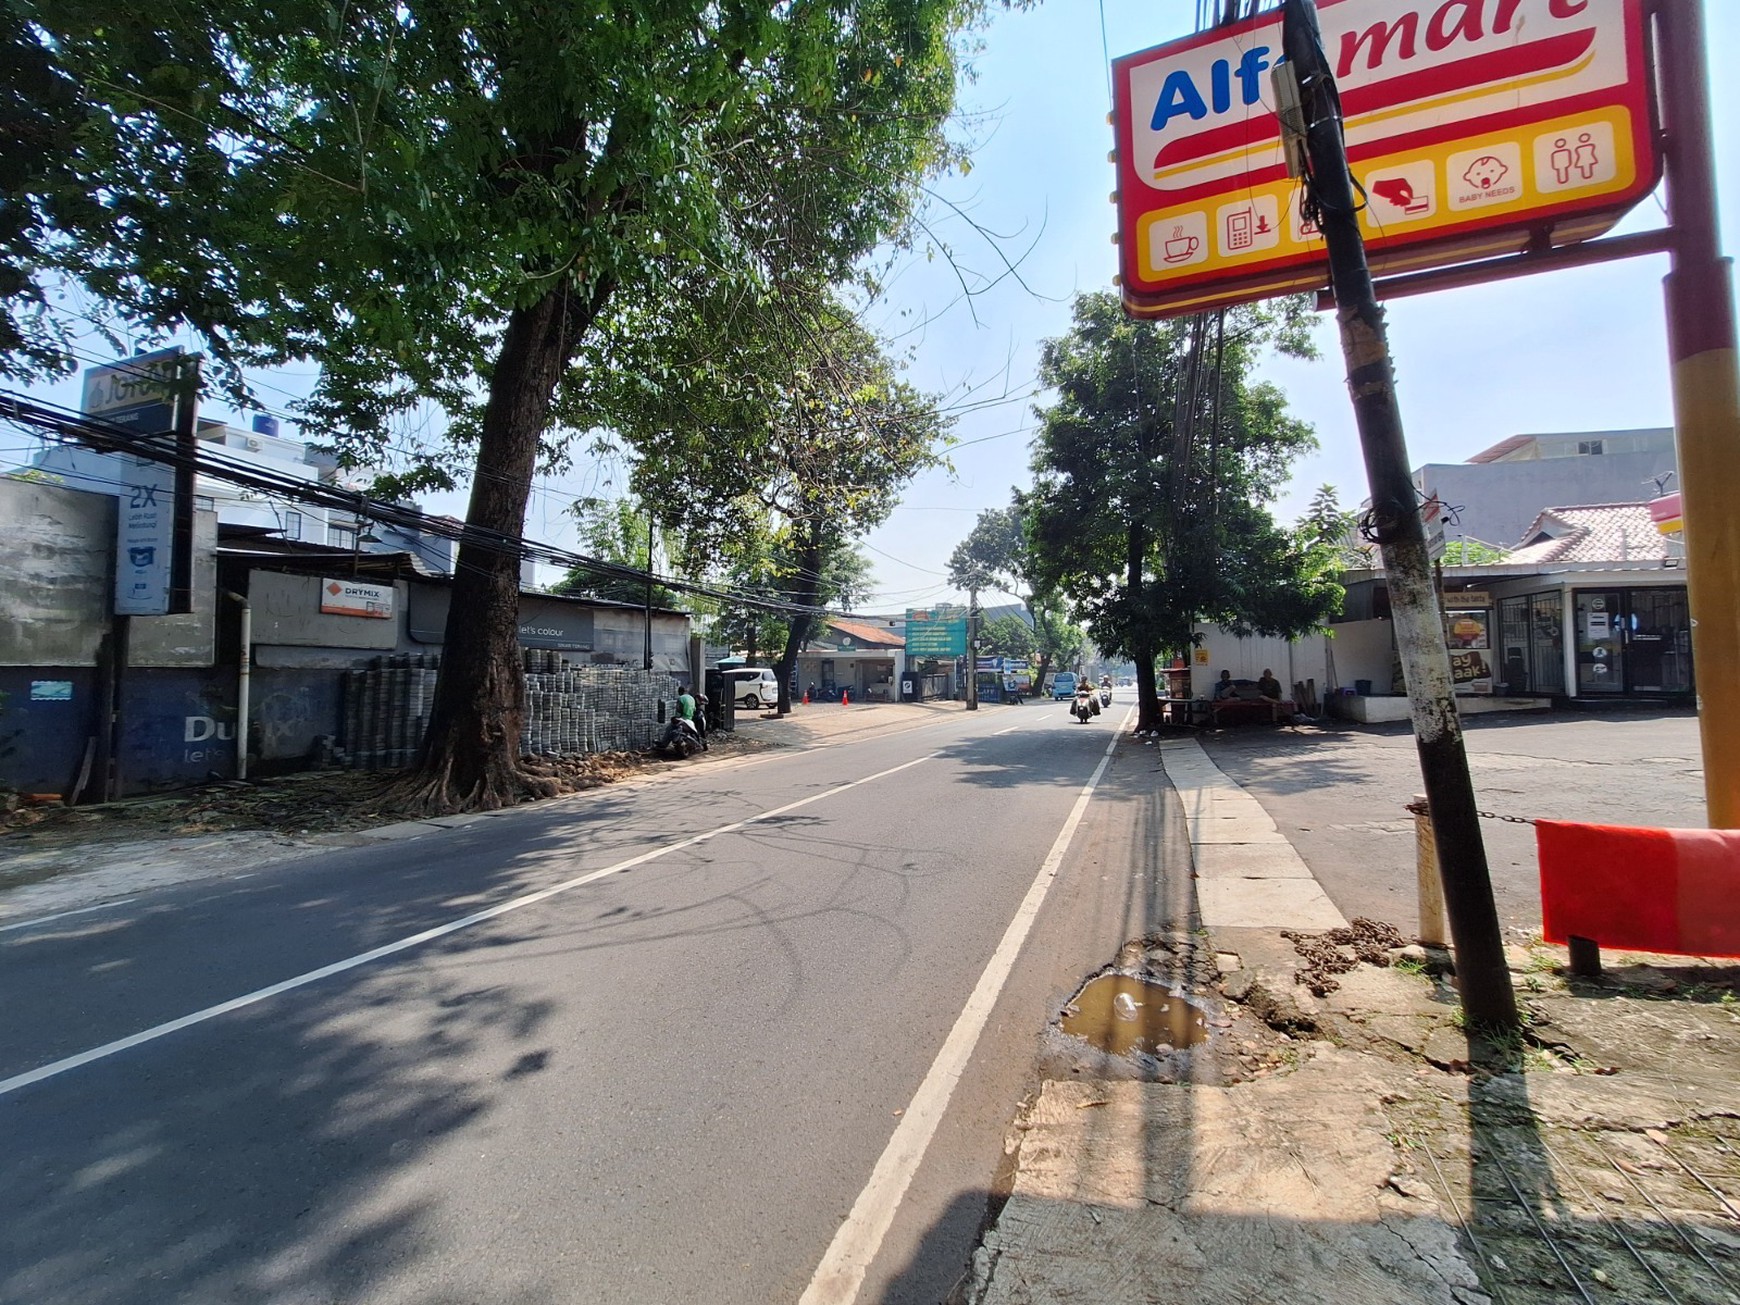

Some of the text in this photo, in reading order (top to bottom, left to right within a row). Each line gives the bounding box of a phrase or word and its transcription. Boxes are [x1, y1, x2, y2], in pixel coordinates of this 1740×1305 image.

[1458, 186, 1516, 203] BABY NEEDS
[130, 484, 158, 509] 2X
[345, 588, 380, 598] DRYMIX
[518, 625, 564, 637] let's colour
